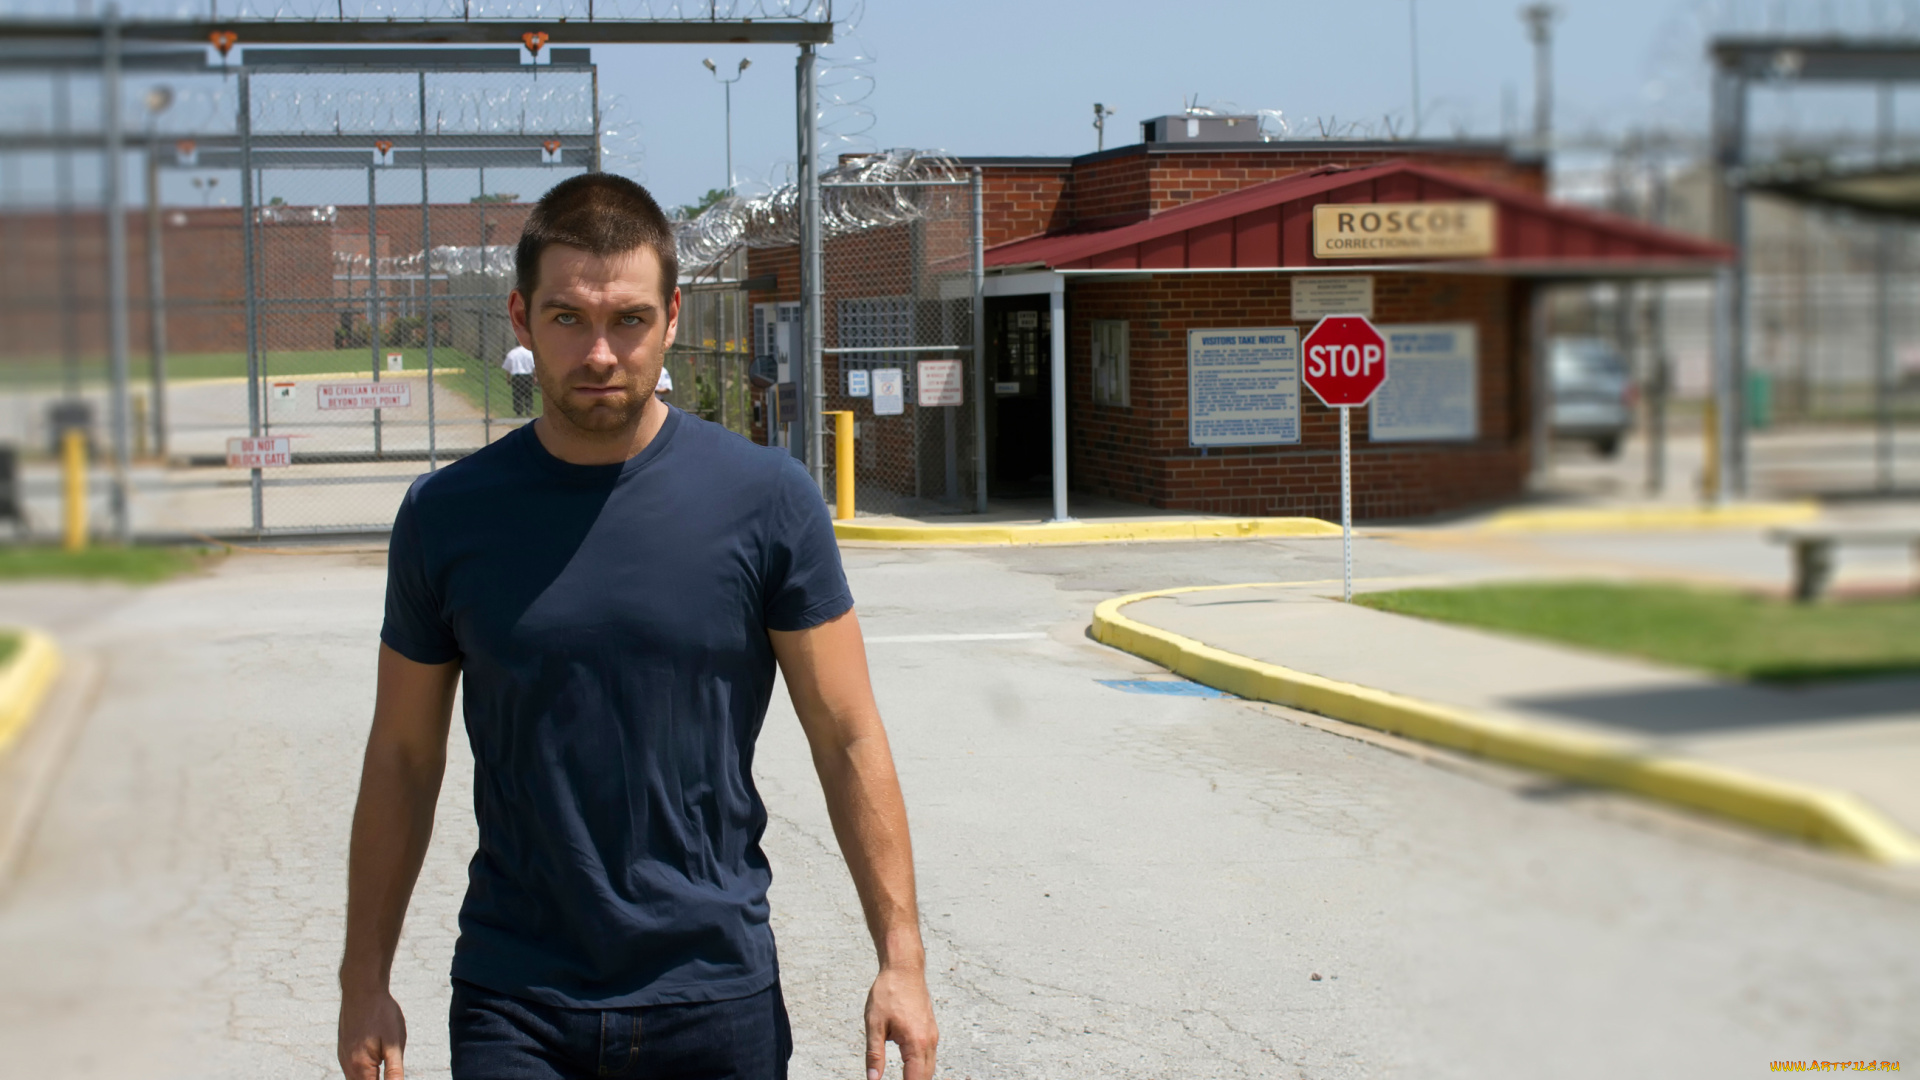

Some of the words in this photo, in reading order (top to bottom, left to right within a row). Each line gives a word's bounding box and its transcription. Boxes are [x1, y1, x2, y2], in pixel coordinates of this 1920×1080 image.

[1337, 210, 1467, 233] ROSCOE
[1202, 336, 1236, 346] VISITORS
[1238, 336, 1256, 345] TAKE
[1259, 335, 1286, 344] NOTICE
[1308, 344, 1382, 377] STOP
[323, 387, 334, 395] NO
[336, 386, 368, 395] CIVILIAN
[371, 385, 406, 395] VEHICLES
[328, 398, 358, 407] BEYOND
[361, 397, 377, 406] THIS
[380, 396, 401, 406] POINT
[242, 440, 254, 452] DO
[258, 440, 275, 451] NOT
[231, 454, 261, 465] BLOCK
[265, 453, 285, 465] GATE
